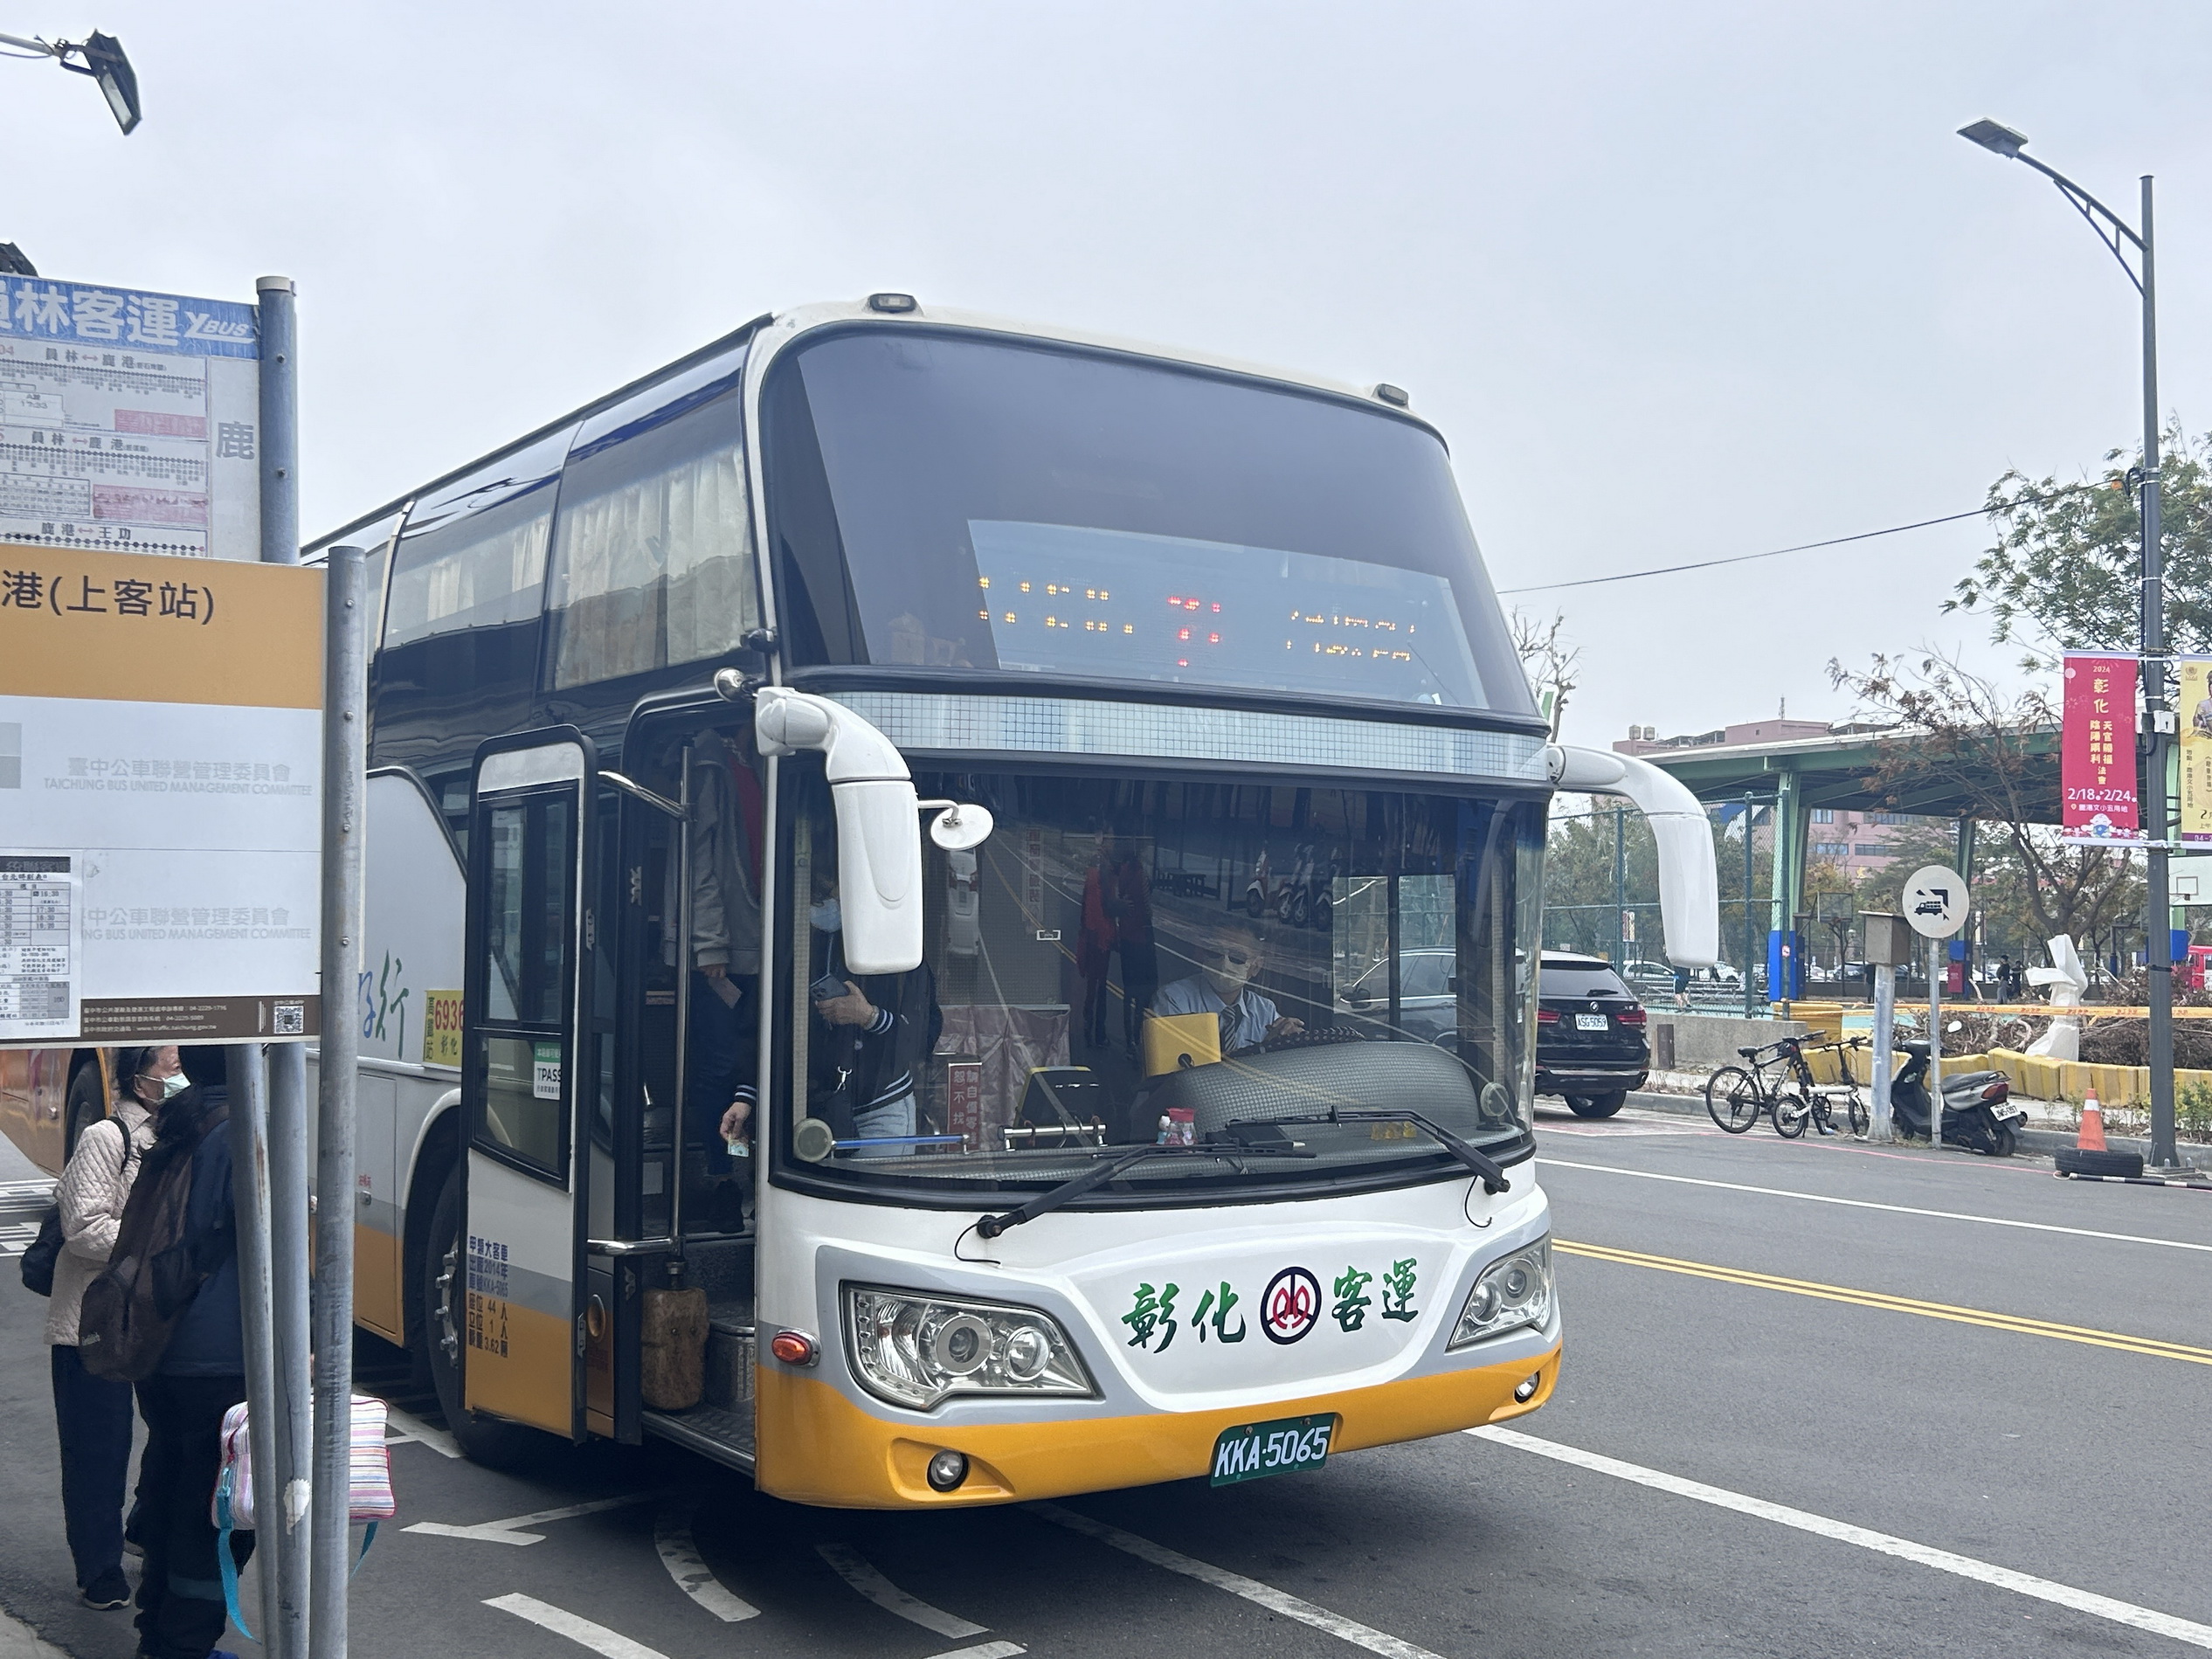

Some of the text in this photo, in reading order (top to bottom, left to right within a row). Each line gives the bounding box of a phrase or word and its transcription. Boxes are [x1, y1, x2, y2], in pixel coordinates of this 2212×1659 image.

[0, 281, 179, 347] 林客運
[102, 354, 134, 369] 鹿港
[89, 437, 123, 451] 鹿港
[216, 421, 255, 460] 鹿
[42, 522, 131, 540] 鹿港 王功
[1, 569, 215, 626] 港(上客站)
[2093, 678, 2109, 714] 彰化
[2098, 766, 2106, 785] 法會
[45, 778, 313, 796] TAICHUNG BUS UNITED MANAGEMENT COMMITTEE
[82, 907, 290, 927] 中公車聯營管理委員會
[106, 929, 126, 940] BUS
[128, 929, 167, 940] UNITED
[168, 928, 248, 940] MANAGEMENT
[251, 928, 312, 939] COMMITTEE
[487, 1299, 496, 1314] 44
[501, 1303, 508, 1321] 人
[1122, 1258, 1419, 1353] 彰化 客運
[501, 1323, 508, 1339] 人
[485, 1337, 500, 1354] 3.62
[1214, 1426, 1331, 1478] KKA-5065
